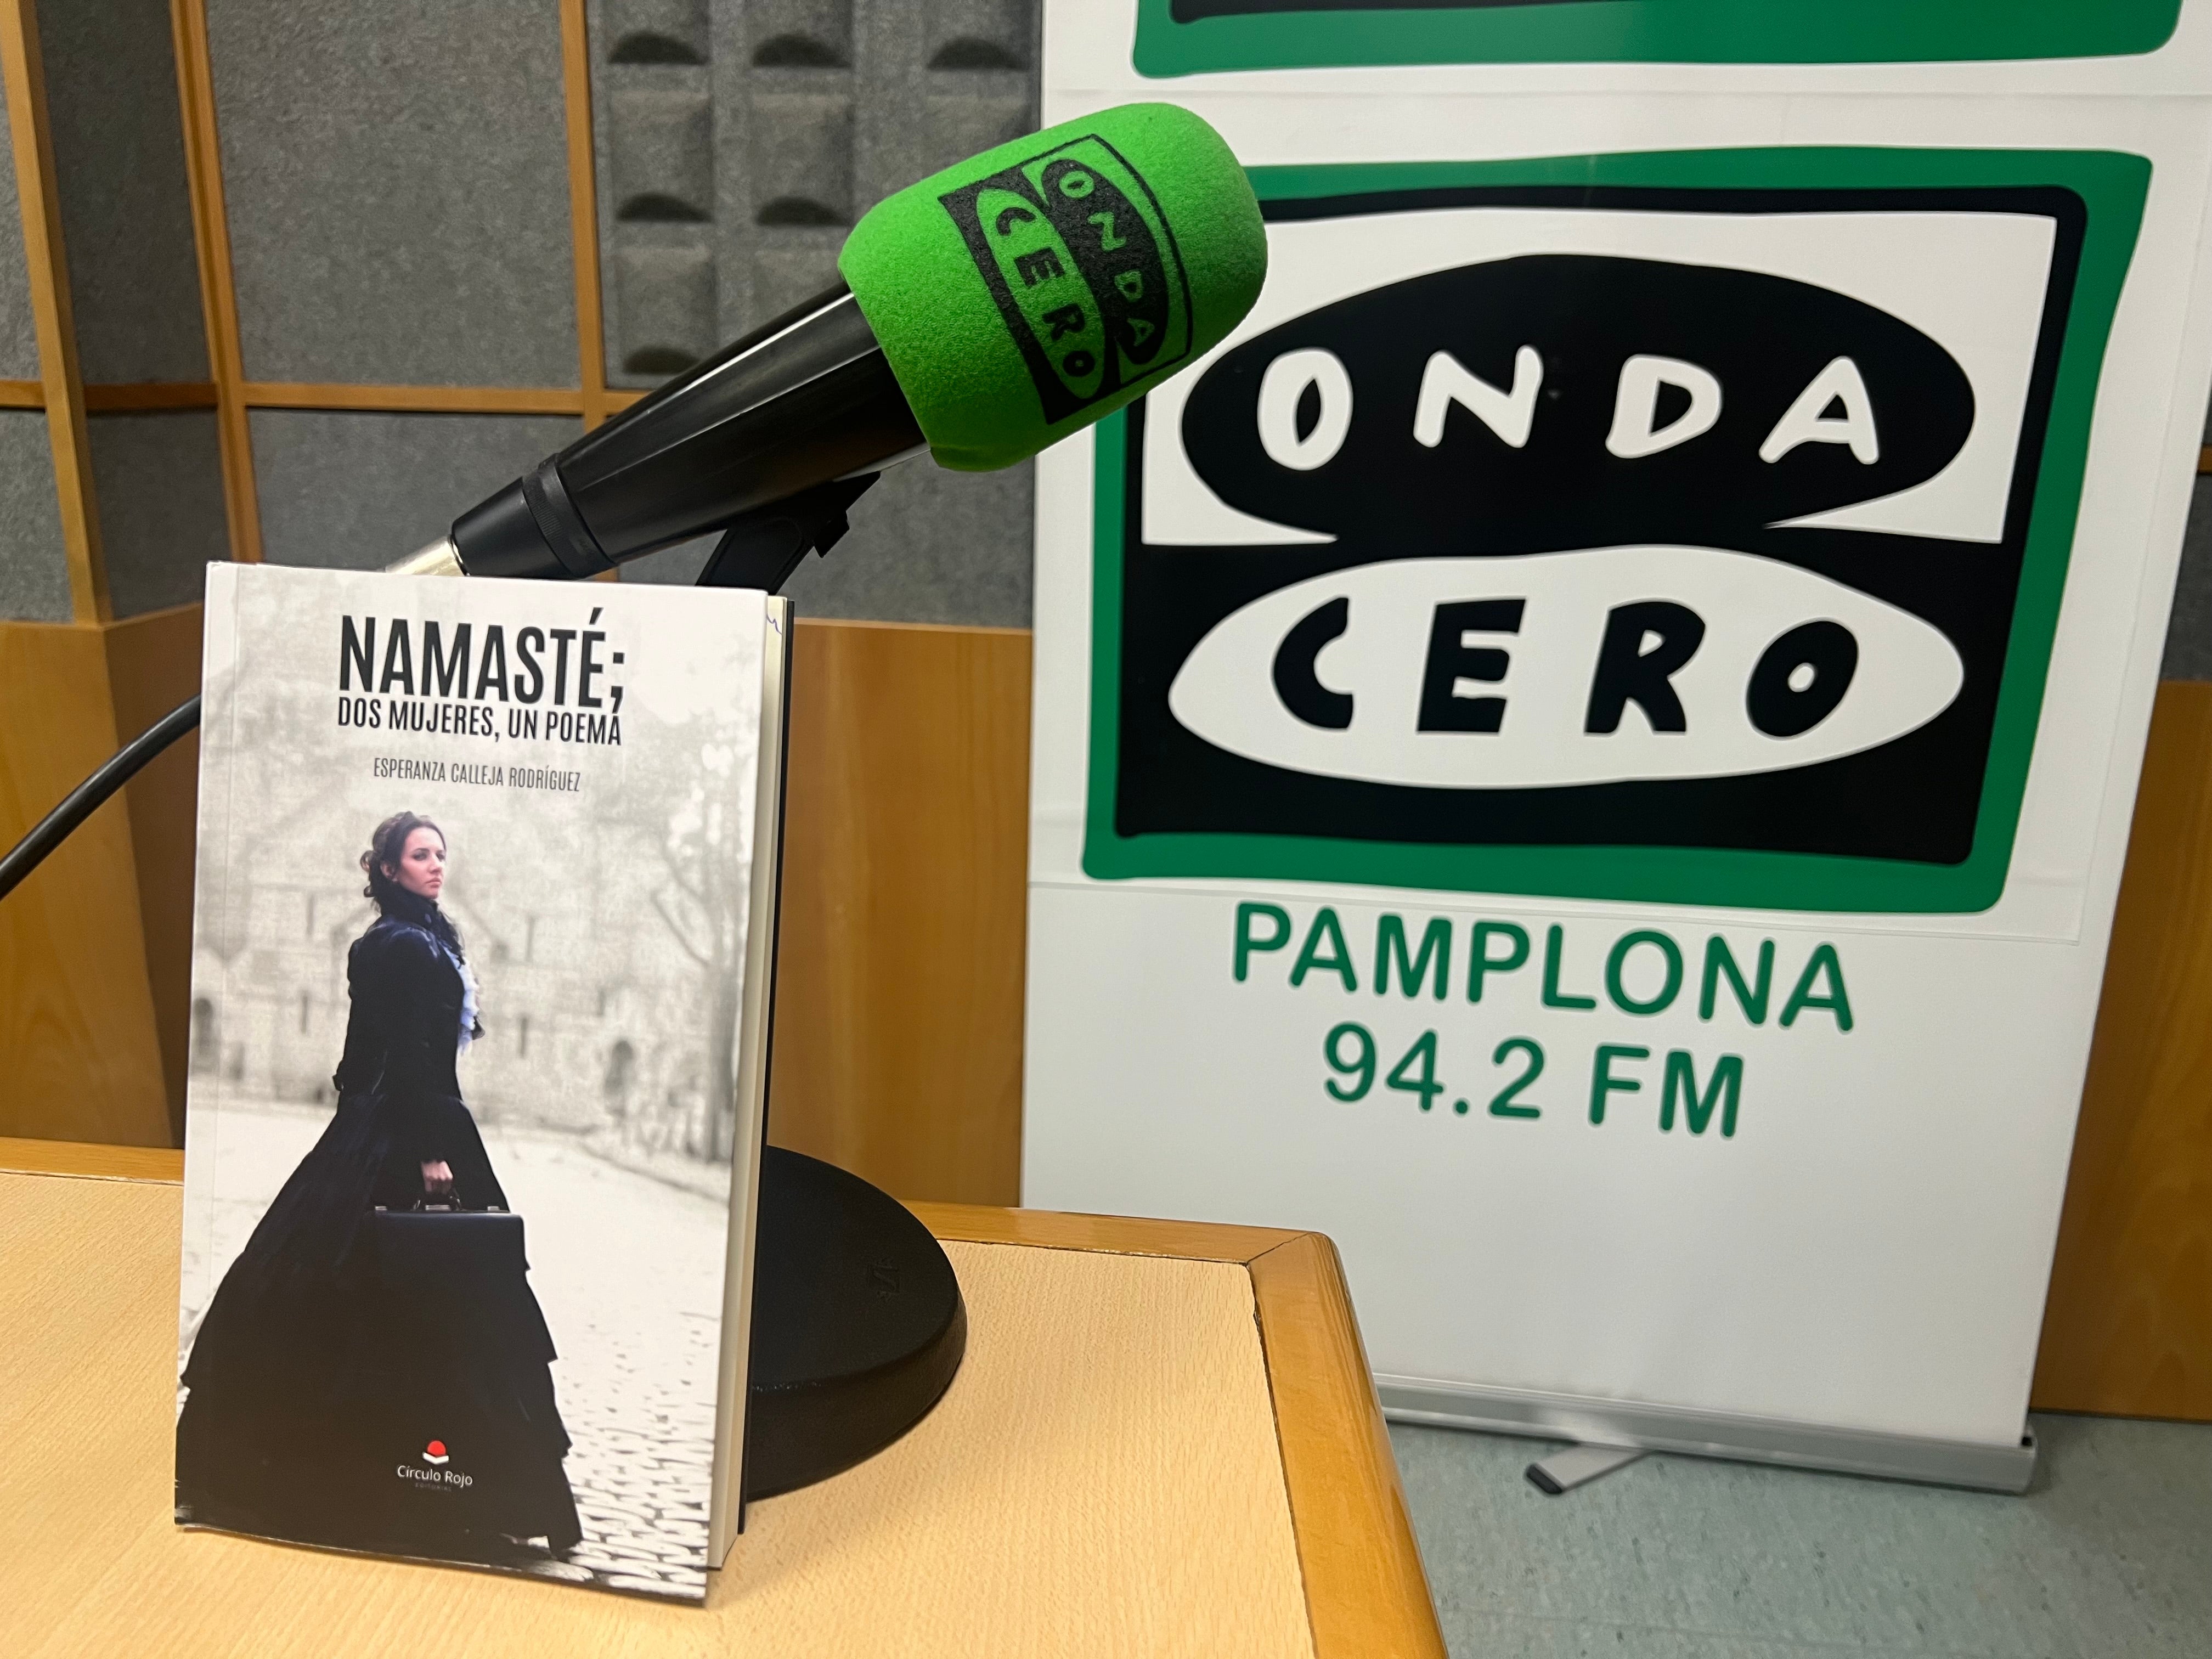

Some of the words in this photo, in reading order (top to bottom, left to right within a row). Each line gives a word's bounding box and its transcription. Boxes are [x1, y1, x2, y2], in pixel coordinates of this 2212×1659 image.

[995, 206, 1096, 377] CERO
[1058, 170, 1155, 347] ONDA
[1256, 345, 1880, 472] ONDA
[337, 696, 381, 729] DOS
[388, 700, 500, 742] MUJERES,
[507, 708, 538, 740] UN
[546, 711, 622, 746] POEMA
[338, 607, 625, 714] NAMASTÉ;
[1271, 596, 1860, 738] CERO
[374, 757, 447, 782] ESPERANZA
[451, 763, 504, 786] CALLEJA
[509, 764, 581, 792] RODRÍGUEZ
[1233, 901, 1854, 1032] PAMPLONA
[1324, 1022, 1545, 1119] 94.2
[1589, 1044, 1745, 1138] FM
[397, 1465, 441, 1482] Círculo
[445, 1471, 473, 1488] Rojo
